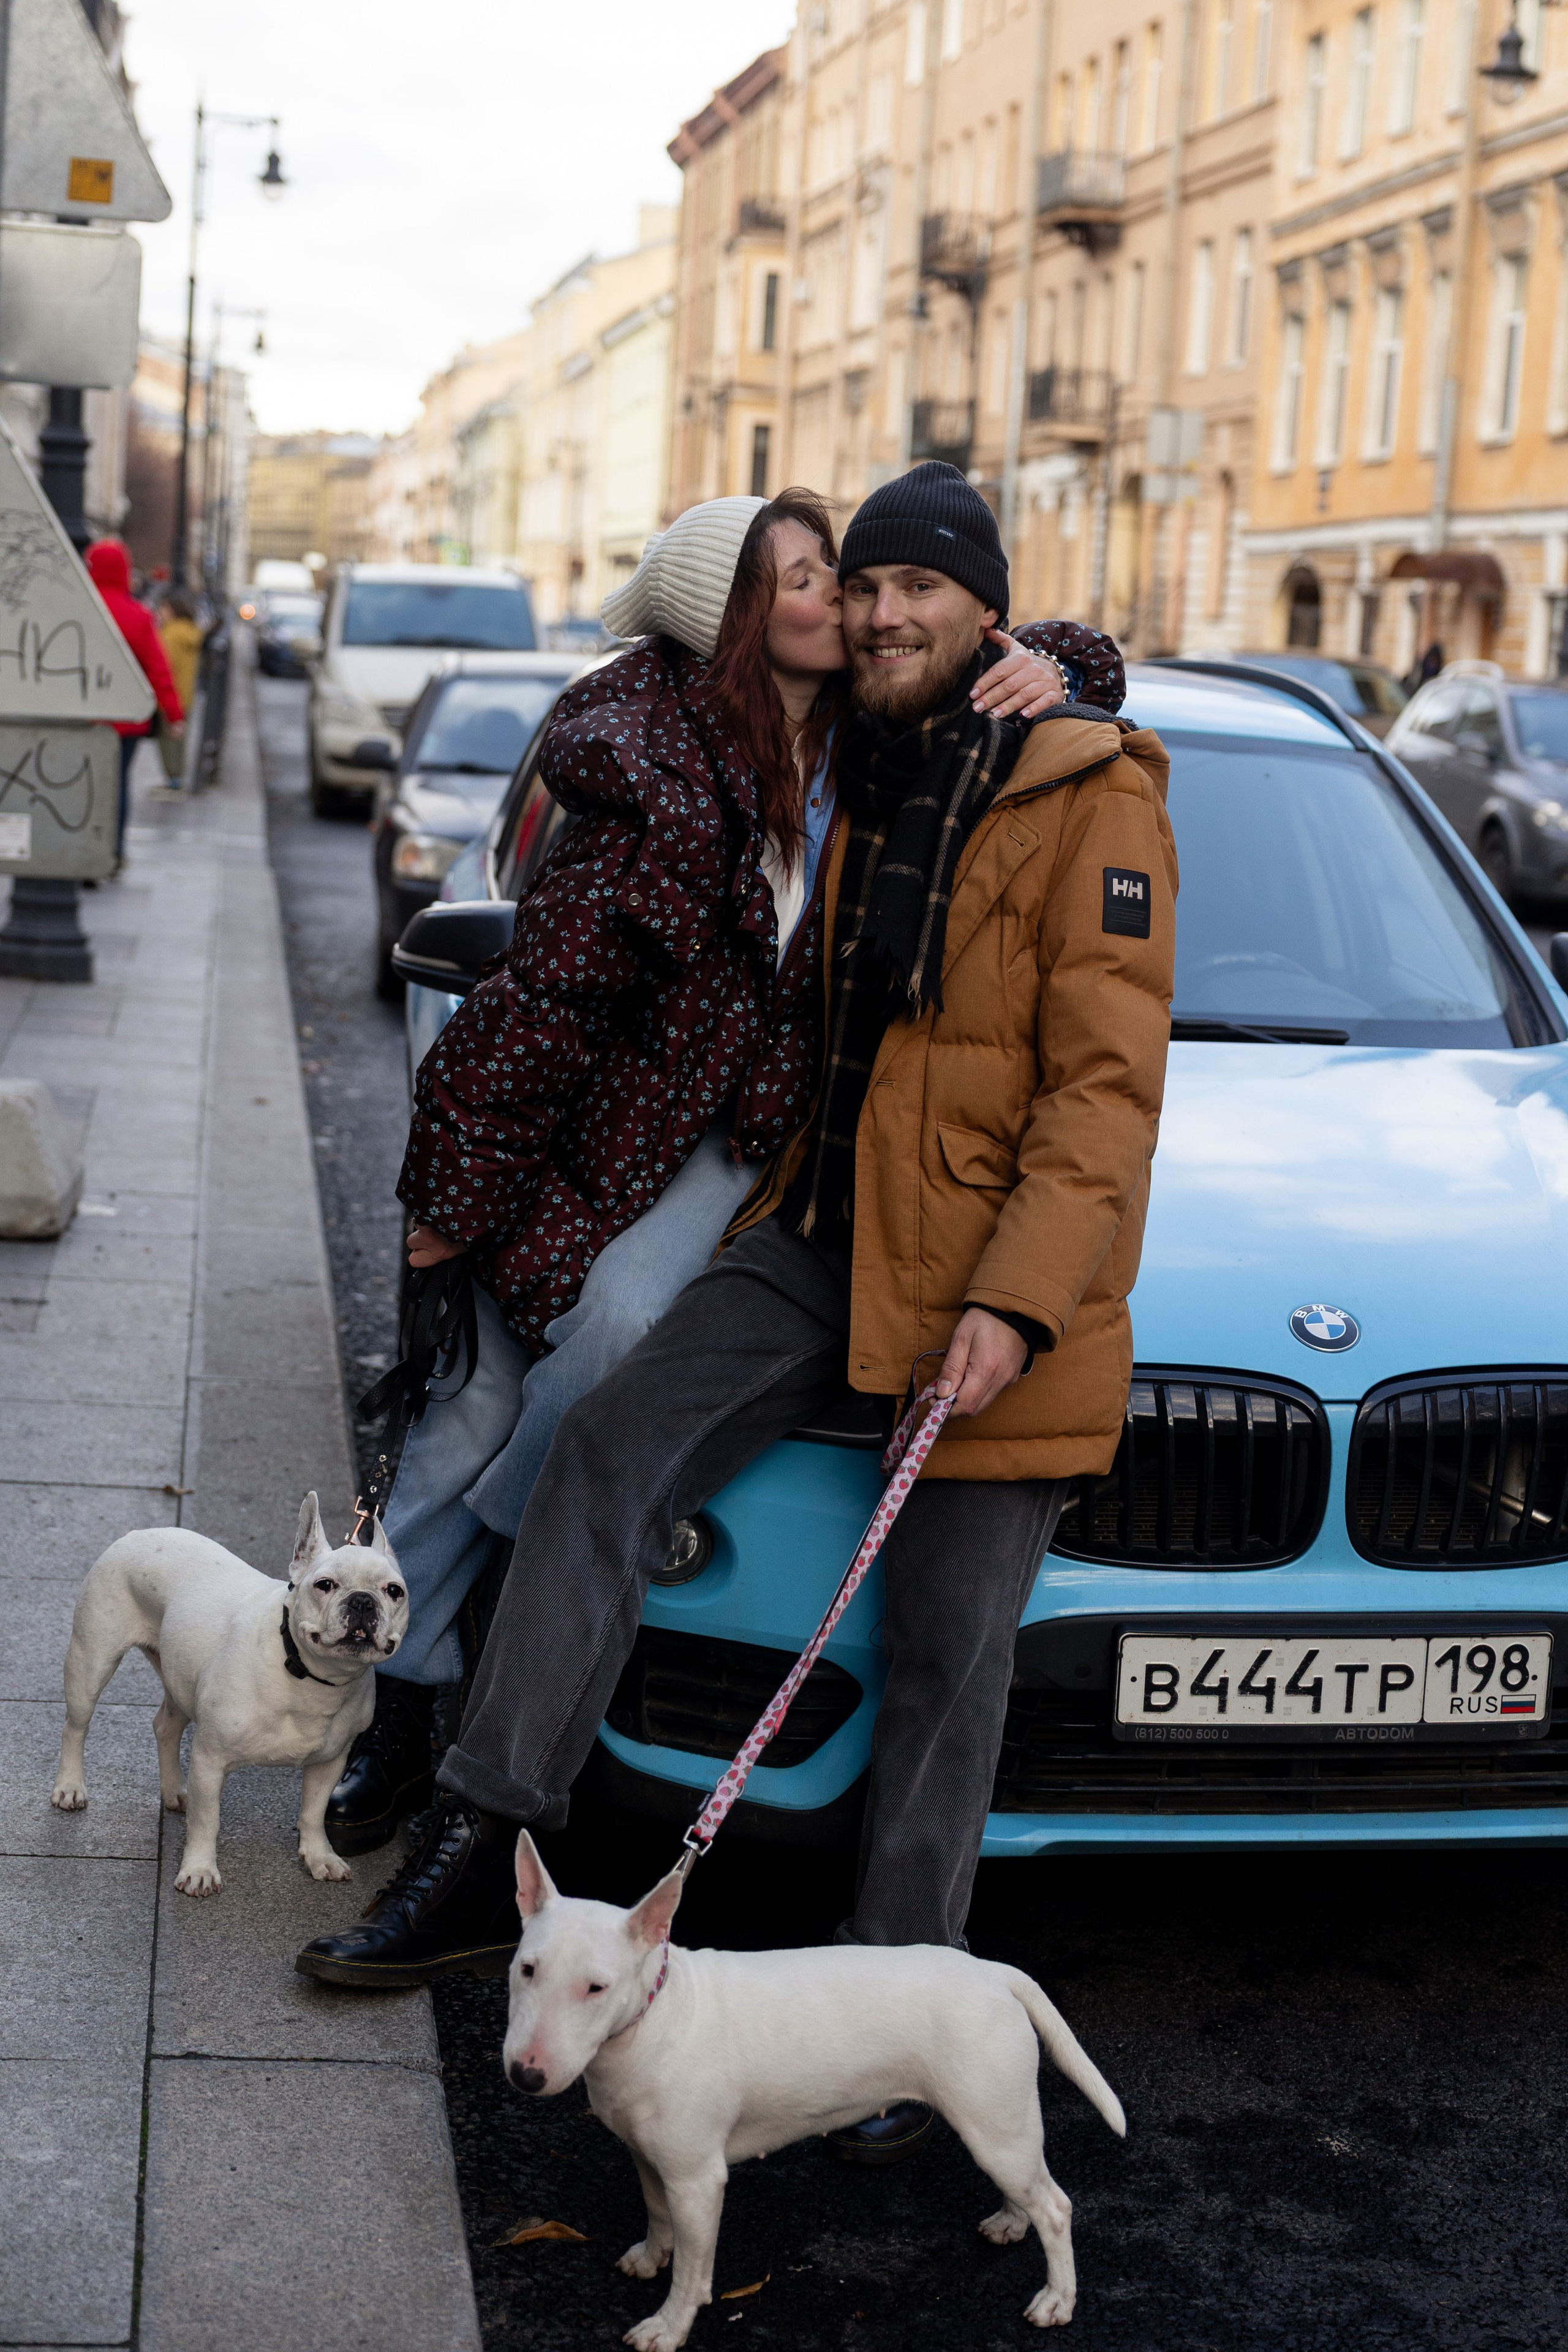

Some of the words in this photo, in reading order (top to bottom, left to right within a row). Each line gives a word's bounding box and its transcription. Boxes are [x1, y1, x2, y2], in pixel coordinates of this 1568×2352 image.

[1112, 878, 1143, 900] HH
[1294, 1305, 1349, 1319] BMW
[1434, 1643, 1530, 1694] 198
[1450, 1695, 1498, 1714] RUS
[1135, 1727, 1166, 1741] (812)
[1170, 1728, 1193, 1740] 500
[1196, 1729, 1219, 1740] 500
